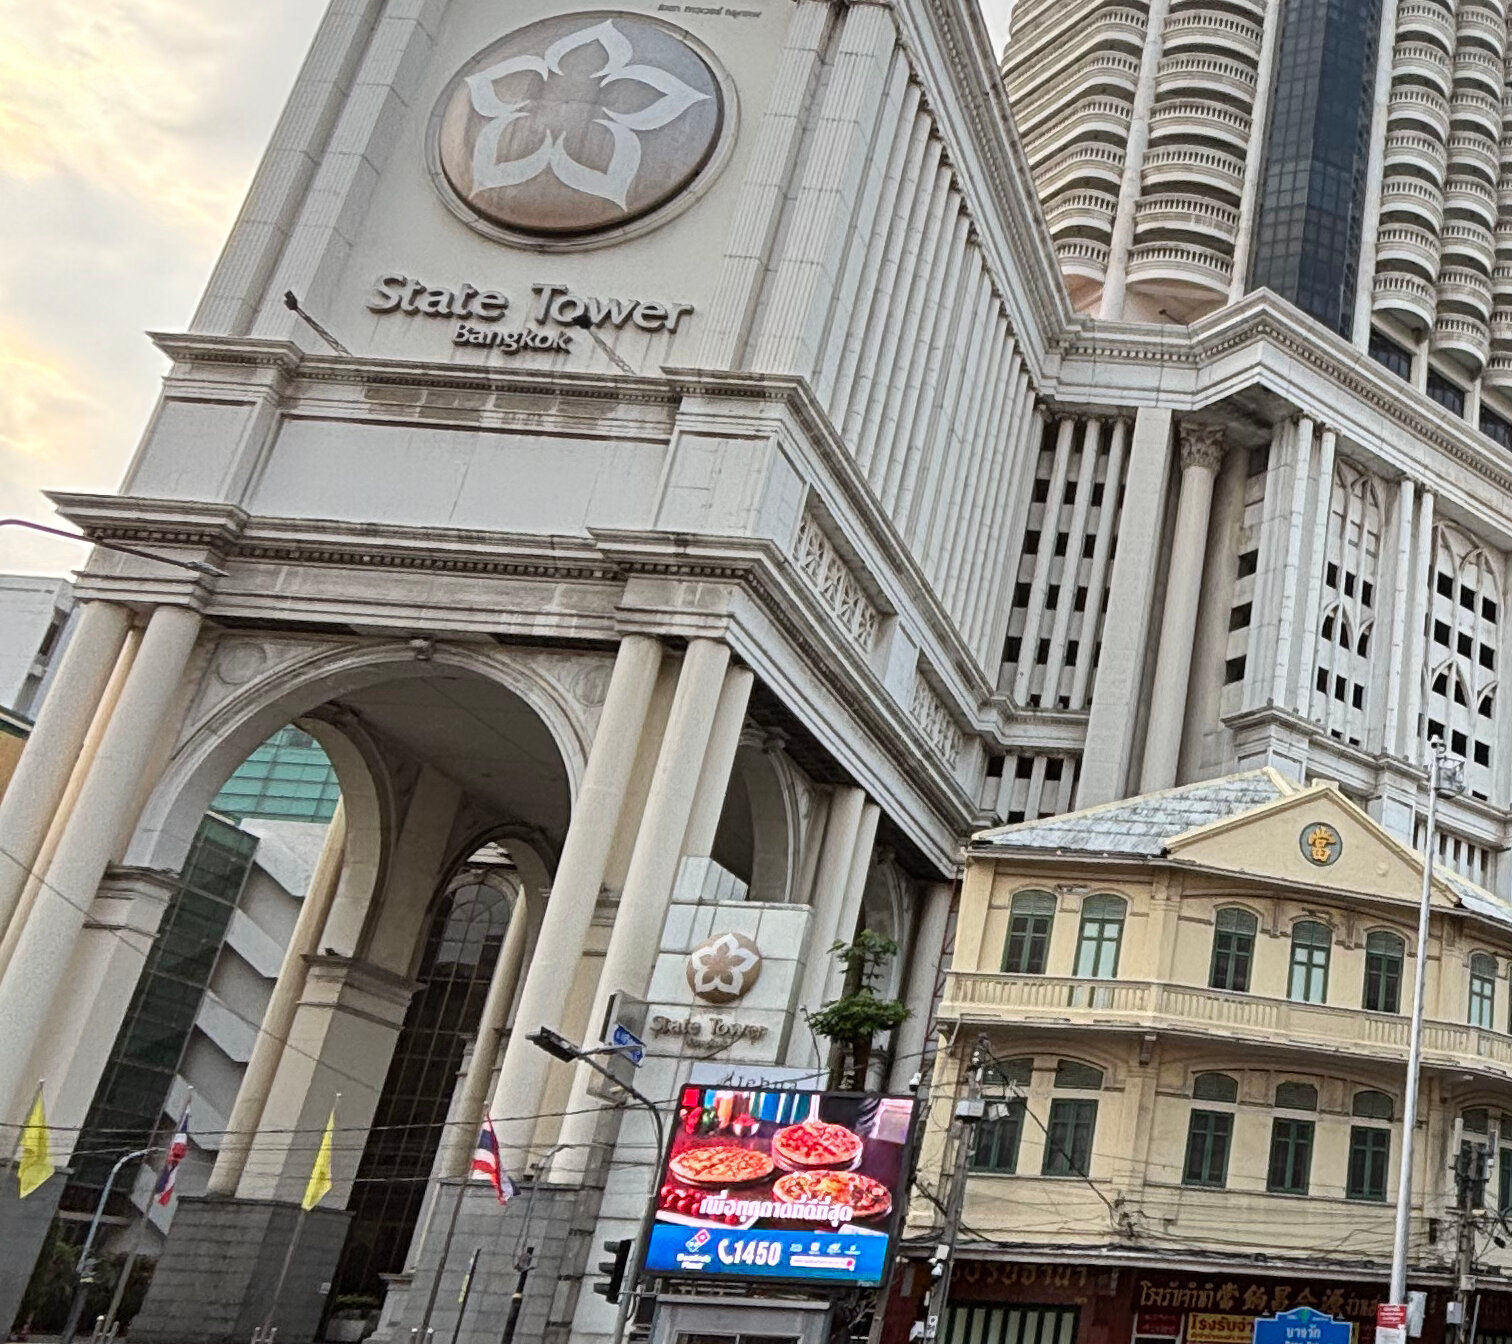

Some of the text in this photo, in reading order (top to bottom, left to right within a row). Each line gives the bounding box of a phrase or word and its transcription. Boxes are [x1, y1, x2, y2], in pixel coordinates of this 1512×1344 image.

[367, 272, 694, 333] State Tower
[452, 323, 575, 355] Bangkok
[650, 1015, 702, 1039] State
[709, 1017, 769, 1046] Tower
[734, 1241, 782, 1266] 1450
[1191, 1314, 1255, 1333] โรงรับจำ
